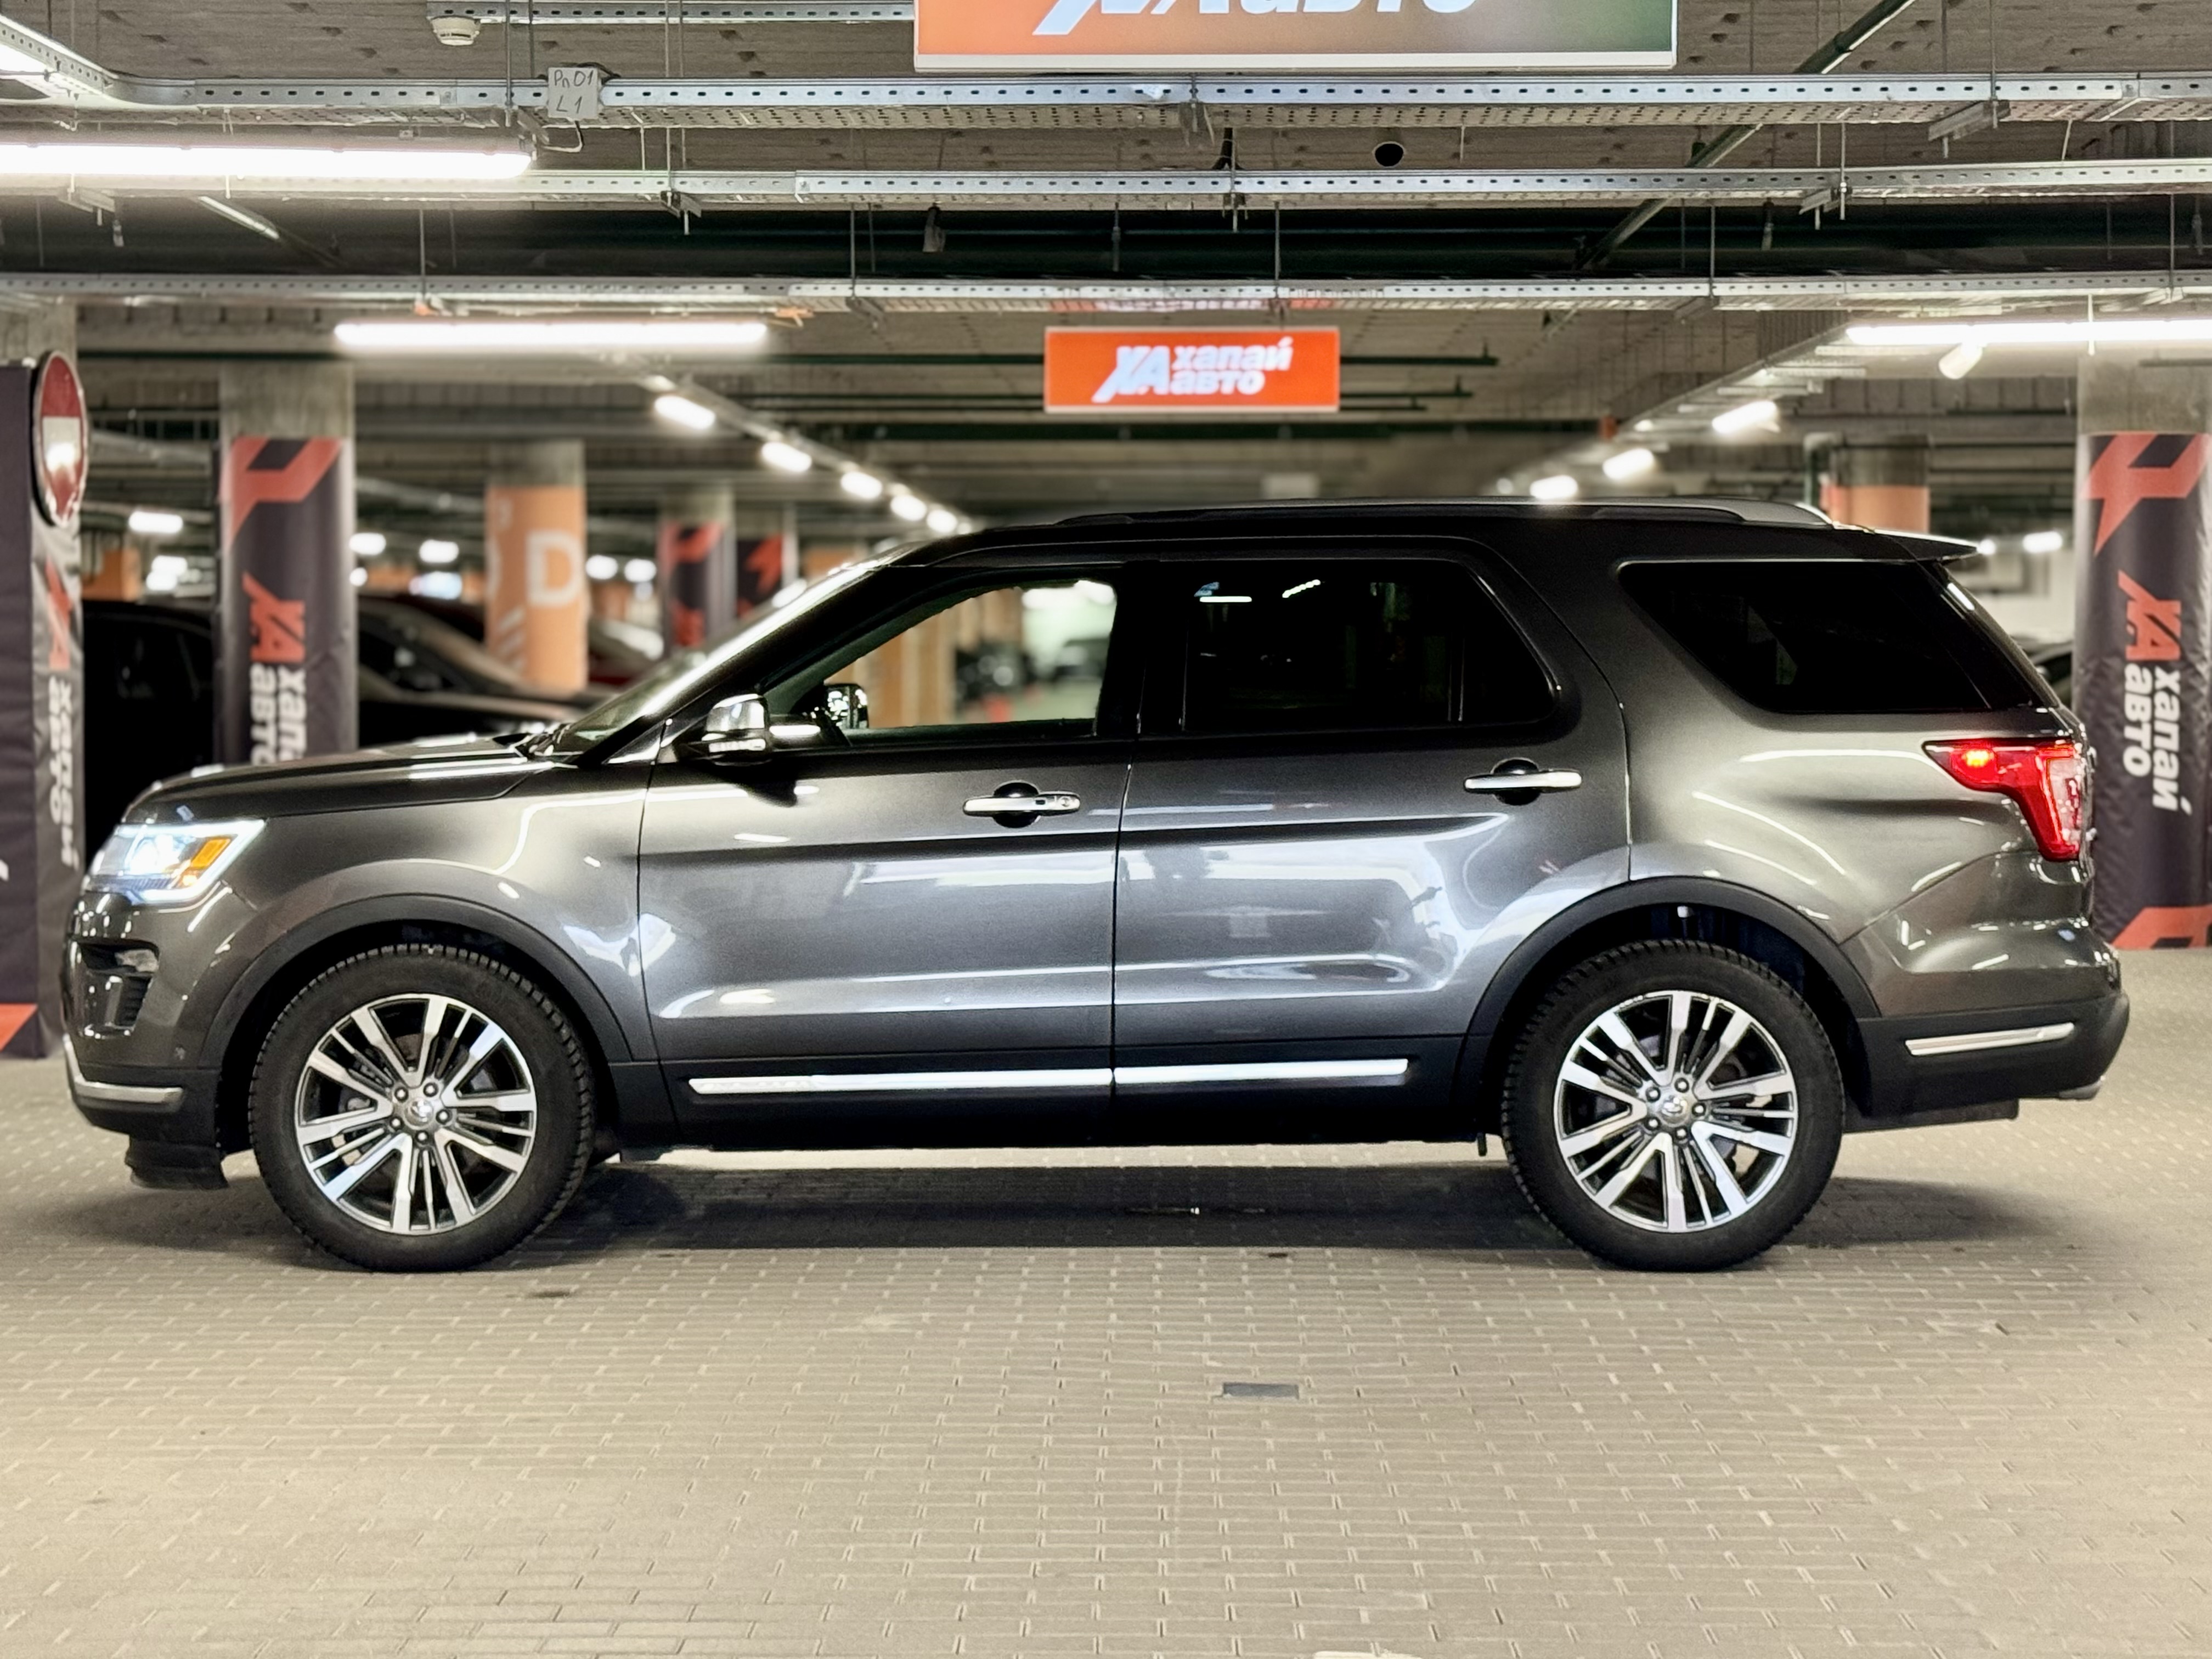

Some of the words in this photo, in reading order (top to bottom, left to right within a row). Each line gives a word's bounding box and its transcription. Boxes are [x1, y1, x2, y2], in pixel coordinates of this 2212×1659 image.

[1170, 370, 1266, 394] авто
[1171, 336, 1293, 371] хапай
[2123, 663, 2153, 777] авто
[2152, 665, 2192, 815] хапай
